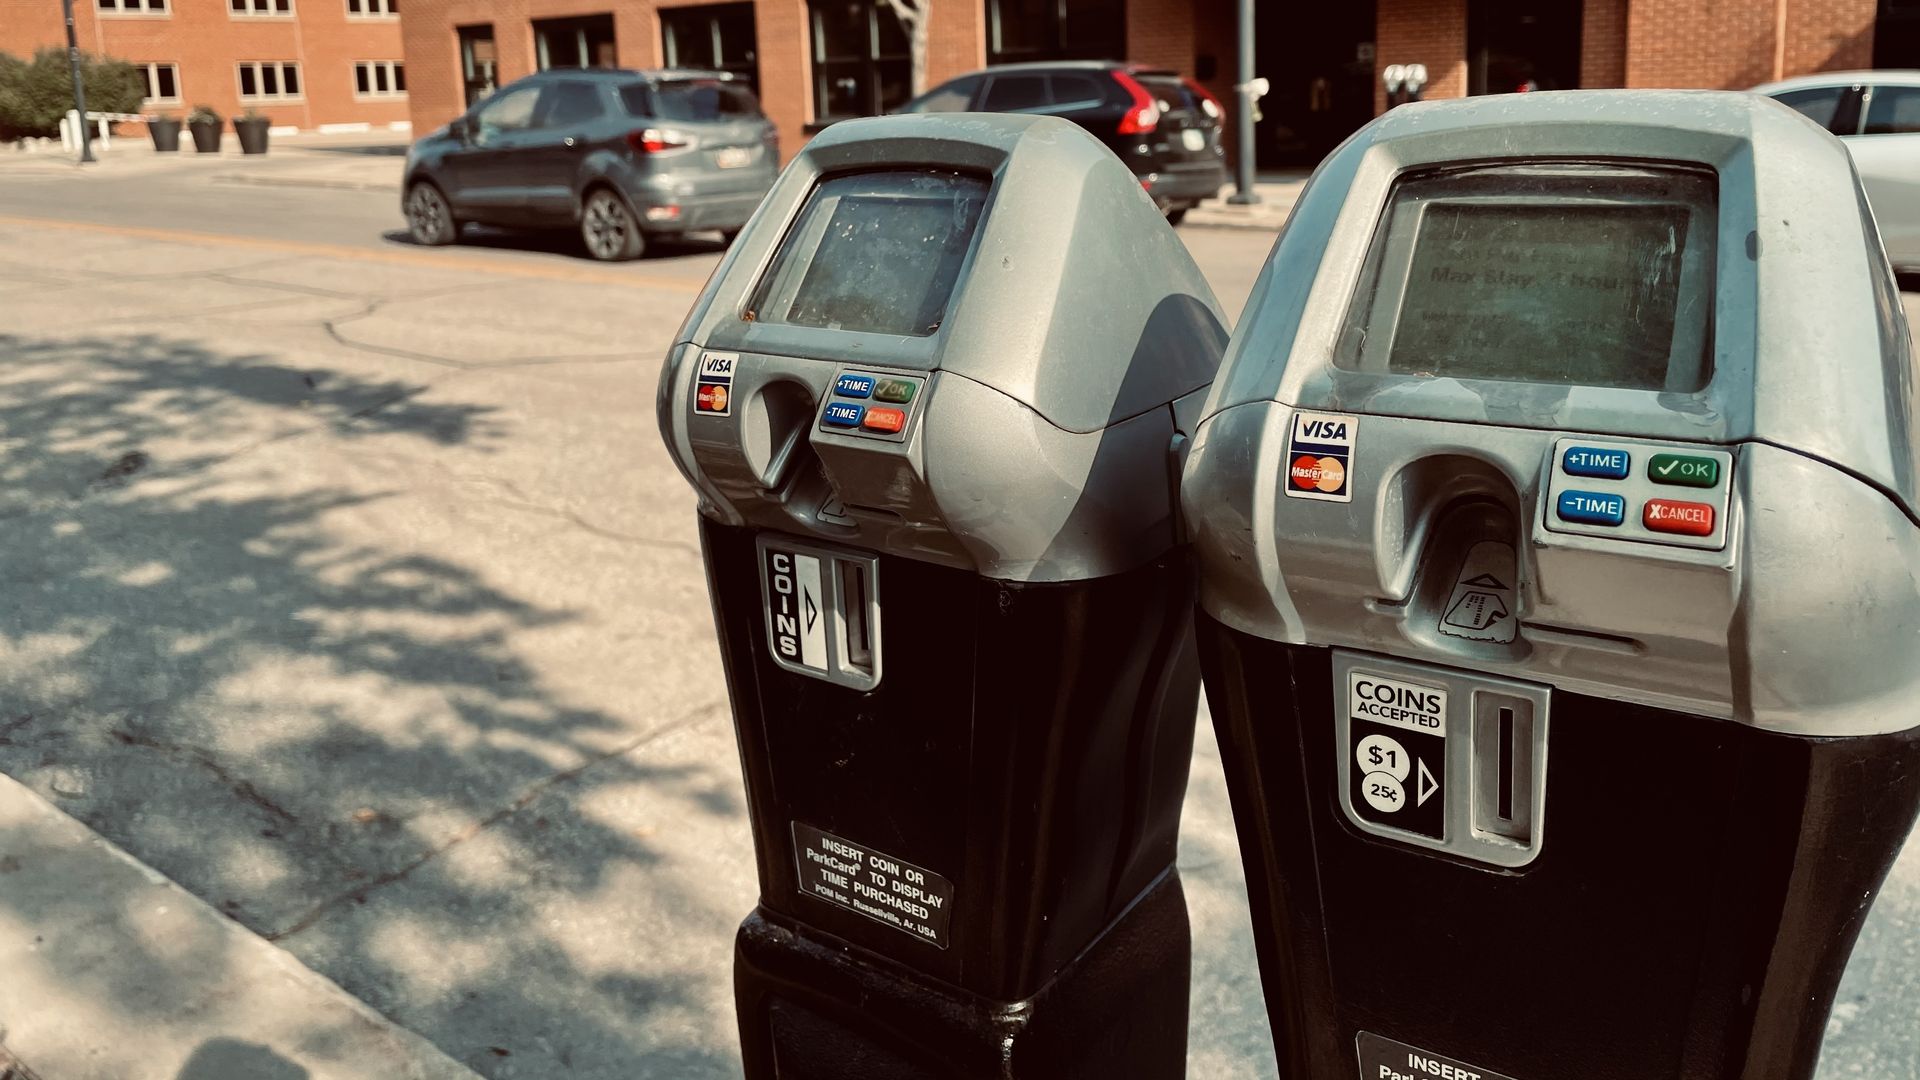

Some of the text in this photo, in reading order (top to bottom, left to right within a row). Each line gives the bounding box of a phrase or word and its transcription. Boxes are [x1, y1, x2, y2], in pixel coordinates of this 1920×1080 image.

[706, 358, 732, 372] VISA
[837, 379, 869, 392] +TIME
[827, 406, 857, 420] -TIME
[1303, 420, 1347, 440] VISA
[1569, 452, 1621, 468] +TIME
[1680, 462, 1708, 477] OK
[1291, 466, 1343, 481] MasterCard
[772, 553, 798, 657] COINS
[1355, 680, 1441, 714] COINS
[1357, 701, 1440, 729] ACCEPTED
[1368, 745, 1396, 769] $1
[1370, 782, 1398, 803] 25¢
[821, 837, 925, 886] INSERT COIN OR
[820, 868, 929, 920] TIME PURCHASED
[869, 871, 887, 887] TO
[892, 880, 944, 909] DISPLAY
[815, 883, 937, 939] POM Inc. Russellville, Ar. USA
[1408, 1053, 1482, 1080] INSERT
